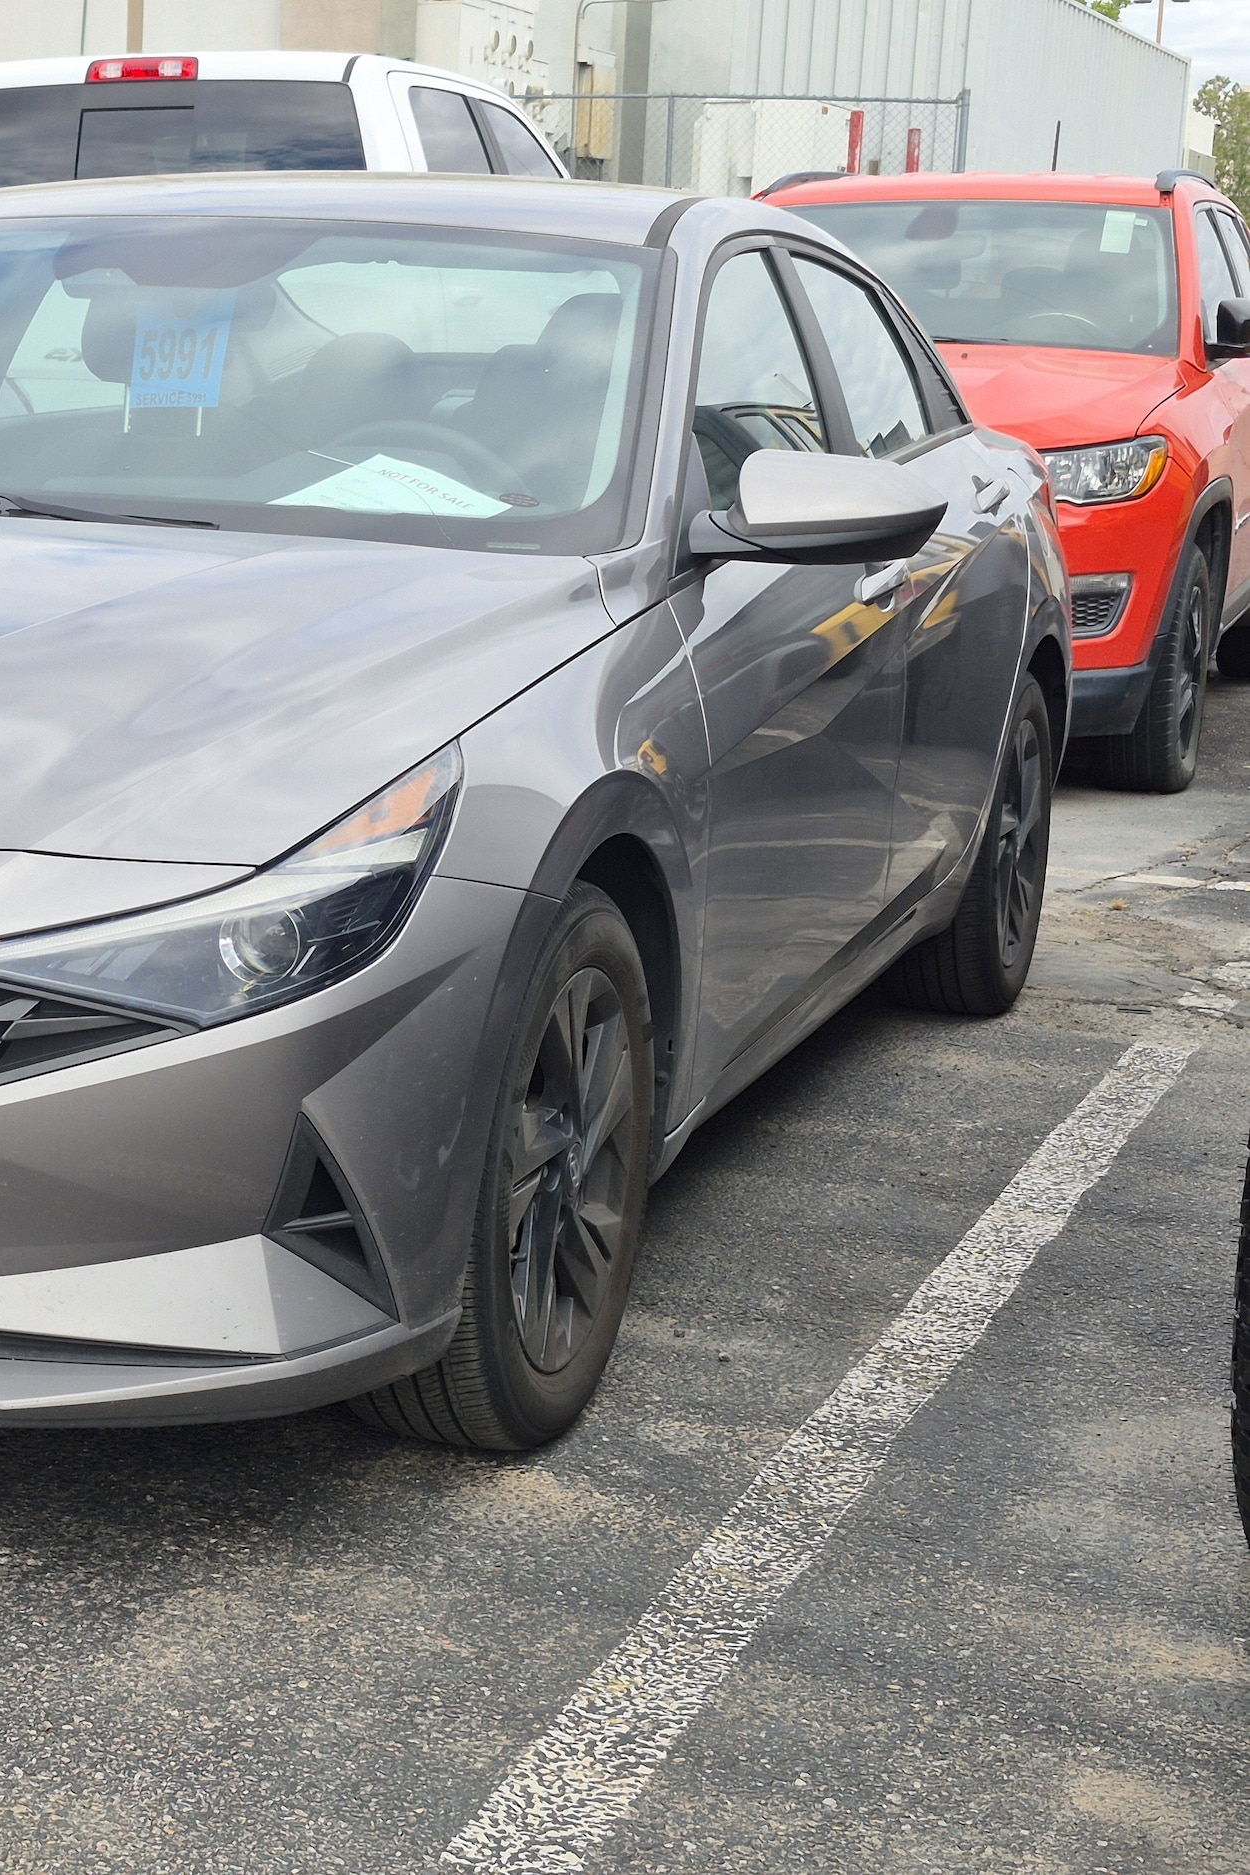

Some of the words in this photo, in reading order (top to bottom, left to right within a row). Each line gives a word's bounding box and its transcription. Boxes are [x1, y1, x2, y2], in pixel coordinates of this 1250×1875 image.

[138, 327, 218, 381] 5991
[136, 391, 184, 405] SERVICE
[187, 392, 207, 402] 5991
[377, 468, 408, 481] NOT
[409, 478, 439, 495] FOR
[438, 492, 475, 509] SALE
